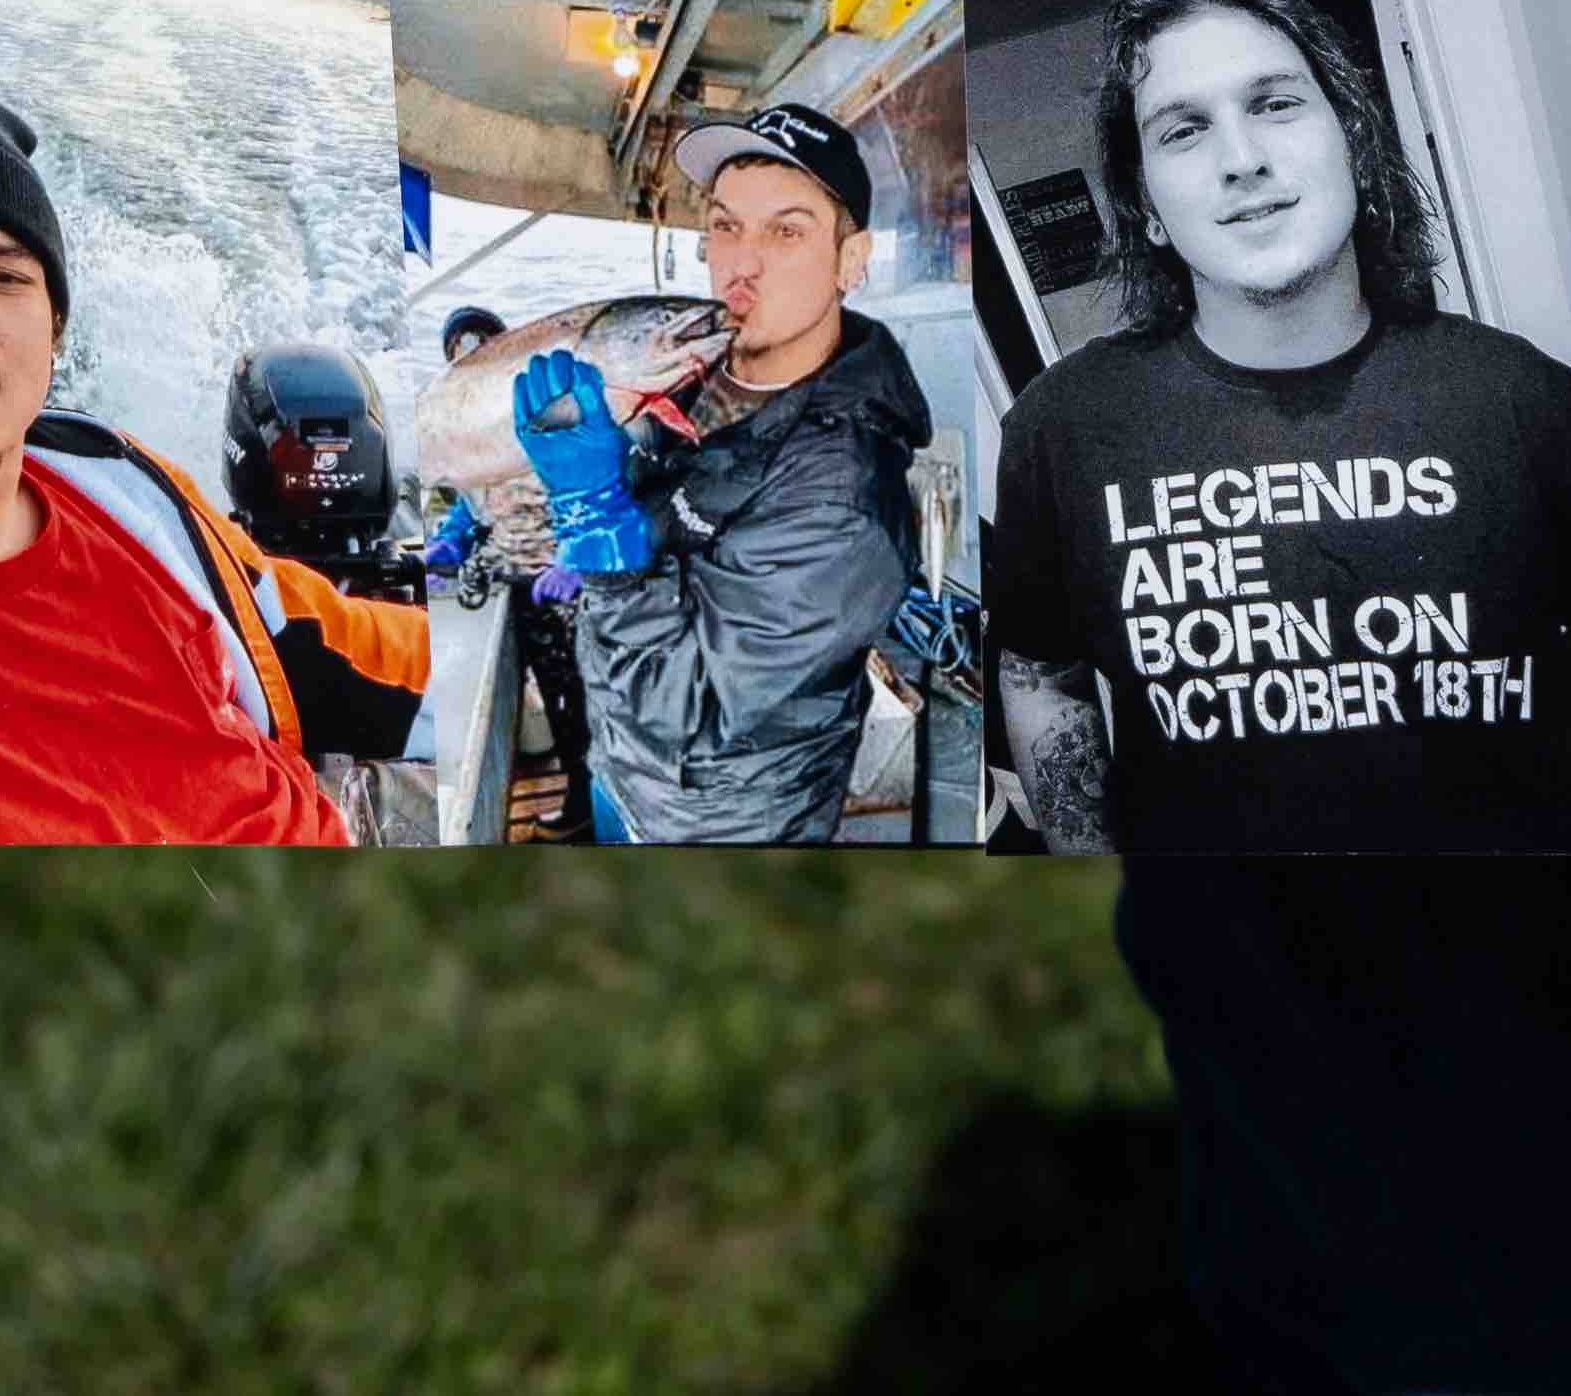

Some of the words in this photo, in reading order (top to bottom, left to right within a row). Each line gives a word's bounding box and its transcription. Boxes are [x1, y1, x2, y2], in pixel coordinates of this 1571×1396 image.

[1104, 456, 1458, 543] LEGENDS
[1120, 534, 1271, 610] ARE
[1125, 597, 1332, 677] BORN
[1354, 592, 1472, 656] ON
[1148, 661, 1407, 742] OCTOBER
[1413, 654, 1533, 723] 18TH
